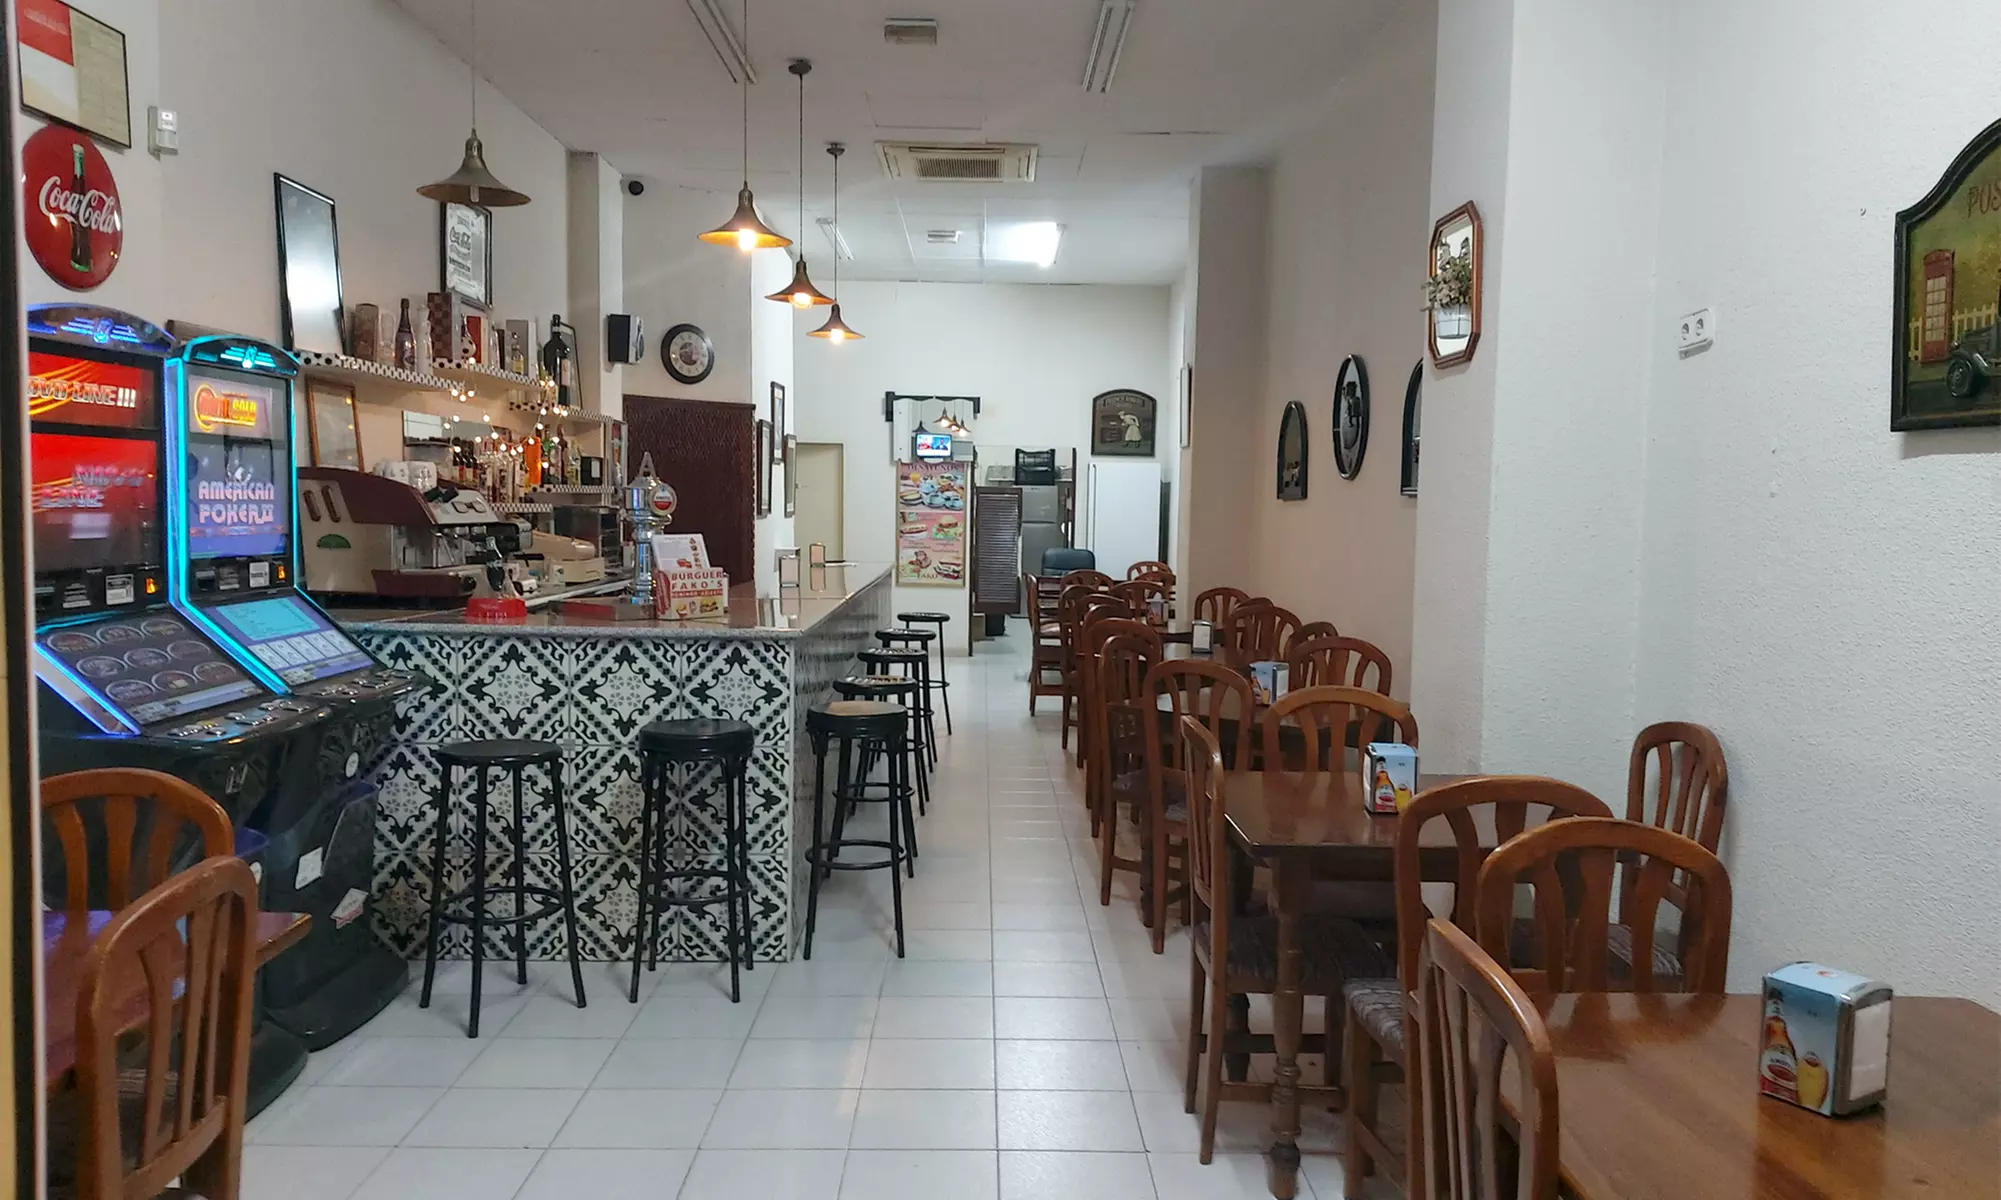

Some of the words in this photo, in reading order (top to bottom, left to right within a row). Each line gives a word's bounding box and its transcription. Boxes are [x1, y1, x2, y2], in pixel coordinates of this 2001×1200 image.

[71, 380, 117, 406] LINE
[198, 480, 275, 502] AMERICAN
[671, 571, 723, 581] BURGUER
